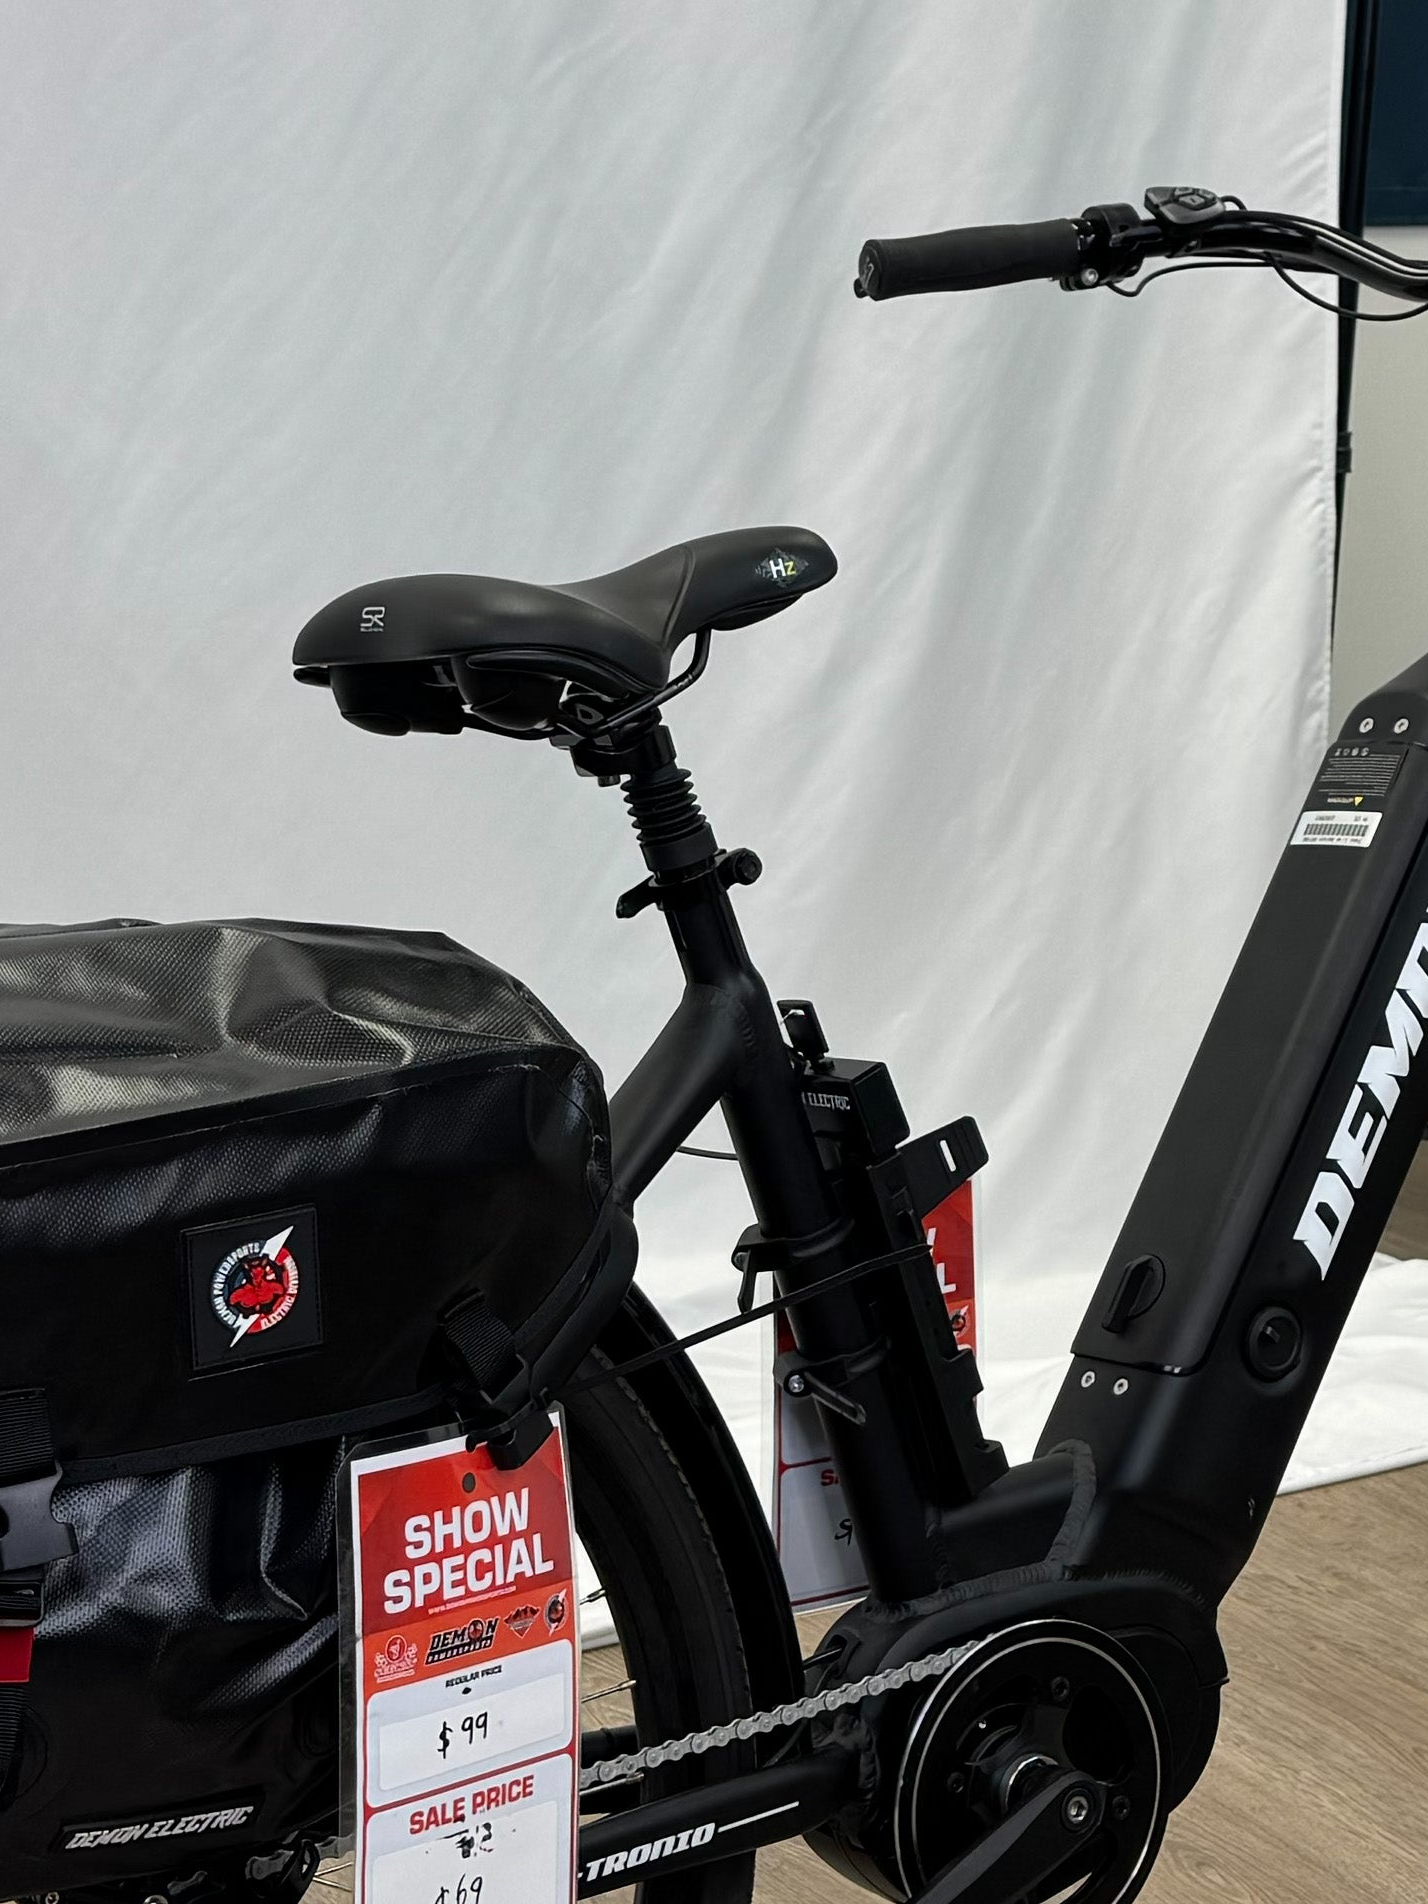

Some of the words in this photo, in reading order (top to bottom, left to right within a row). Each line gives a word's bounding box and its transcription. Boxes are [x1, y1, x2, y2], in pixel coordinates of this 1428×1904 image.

[769, 558, 796, 579] Hz
[404, 1487, 529, 1559] SHOW
[383, 1533, 554, 1614] SPECIAL
[65, 1823, 148, 1850] DEMON
[144, 1806, 254, 1840] ELECTRIC
[409, 1797, 465, 1835] SALE
[471, 1774, 534, 1816] PRICE
